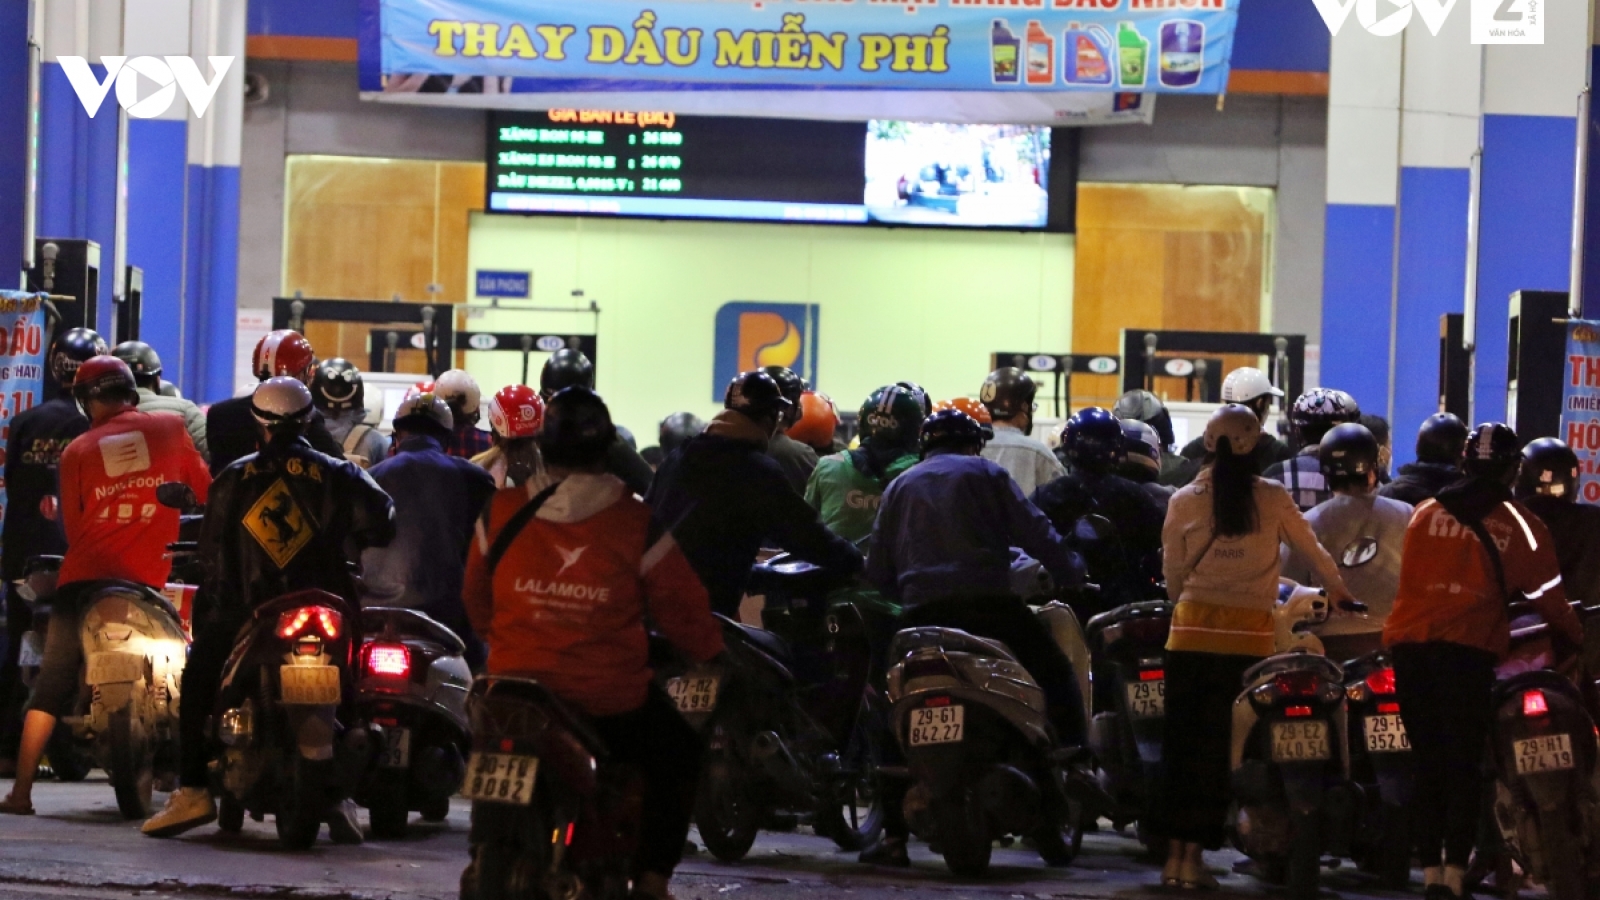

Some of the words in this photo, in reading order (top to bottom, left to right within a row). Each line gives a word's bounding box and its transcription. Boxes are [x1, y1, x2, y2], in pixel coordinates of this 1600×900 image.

[428, 19, 575, 60] THAY
[587, 10, 702, 67] DẦU
[714, 12, 848, 70] MIỄN
[858, 24, 950, 72] PHÍ
[478, 335, 491, 346] 11
[543, 338, 559, 348] 10
[867, 414, 898, 429] Grab
[1214, 549, 1245, 559] PARIS
[514, 578, 611, 602] LALAMOVE
[917, 707, 956, 725] 29-G1
[1279, 723, 1321, 740] 29-E2
[1522, 737, 1564, 755] 29-H1
